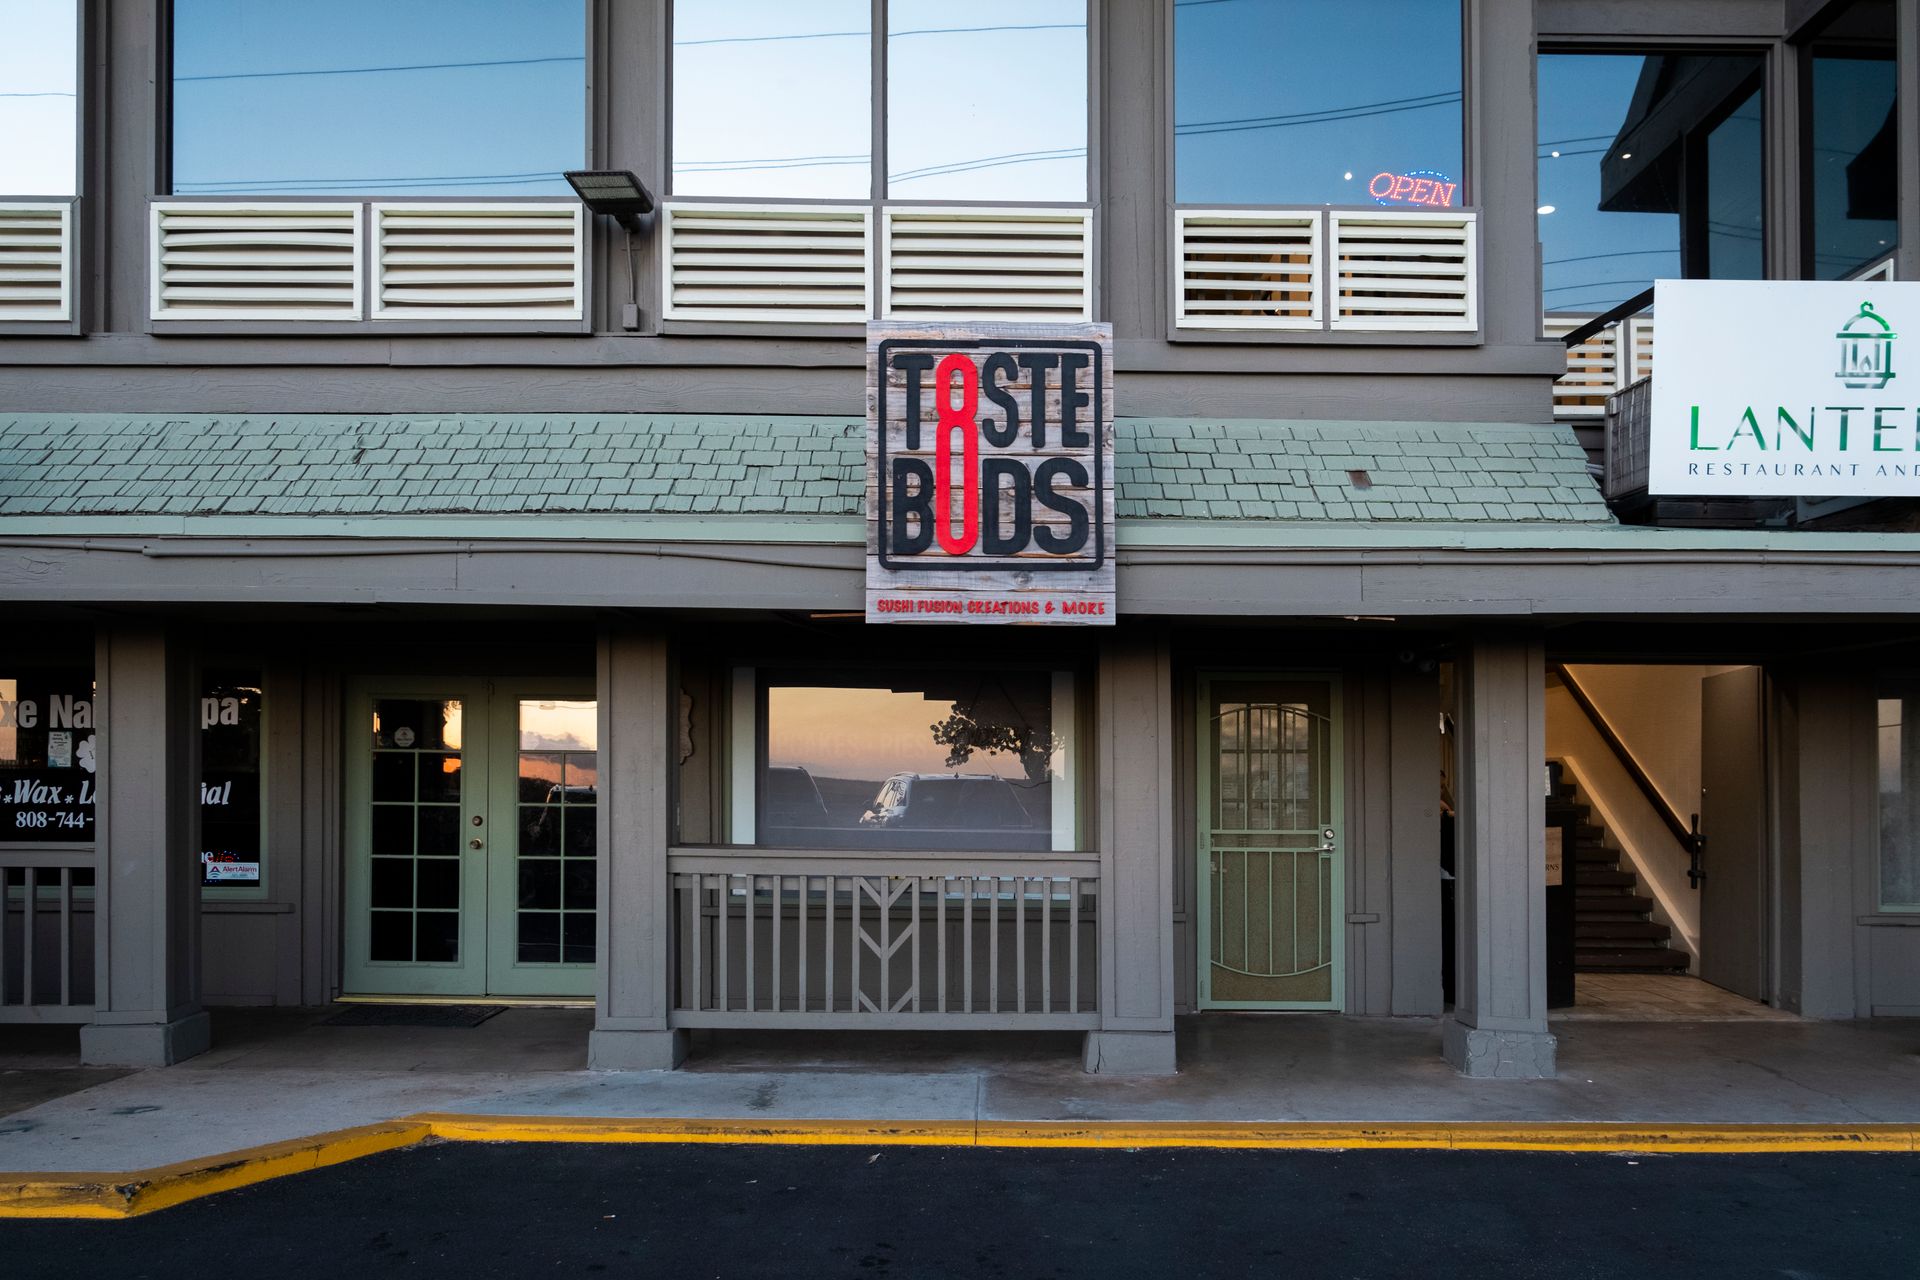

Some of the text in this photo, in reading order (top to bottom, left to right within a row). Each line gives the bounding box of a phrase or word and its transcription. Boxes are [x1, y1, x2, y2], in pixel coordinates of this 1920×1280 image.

[1368, 172, 1457, 208] OPEN
[1689, 405, 1920, 452] LANTE
[1688, 462, 1860, 477] RESTAURANT
[877, 599, 1105, 615] SUSHI FUSION CREATIONS & MORE
